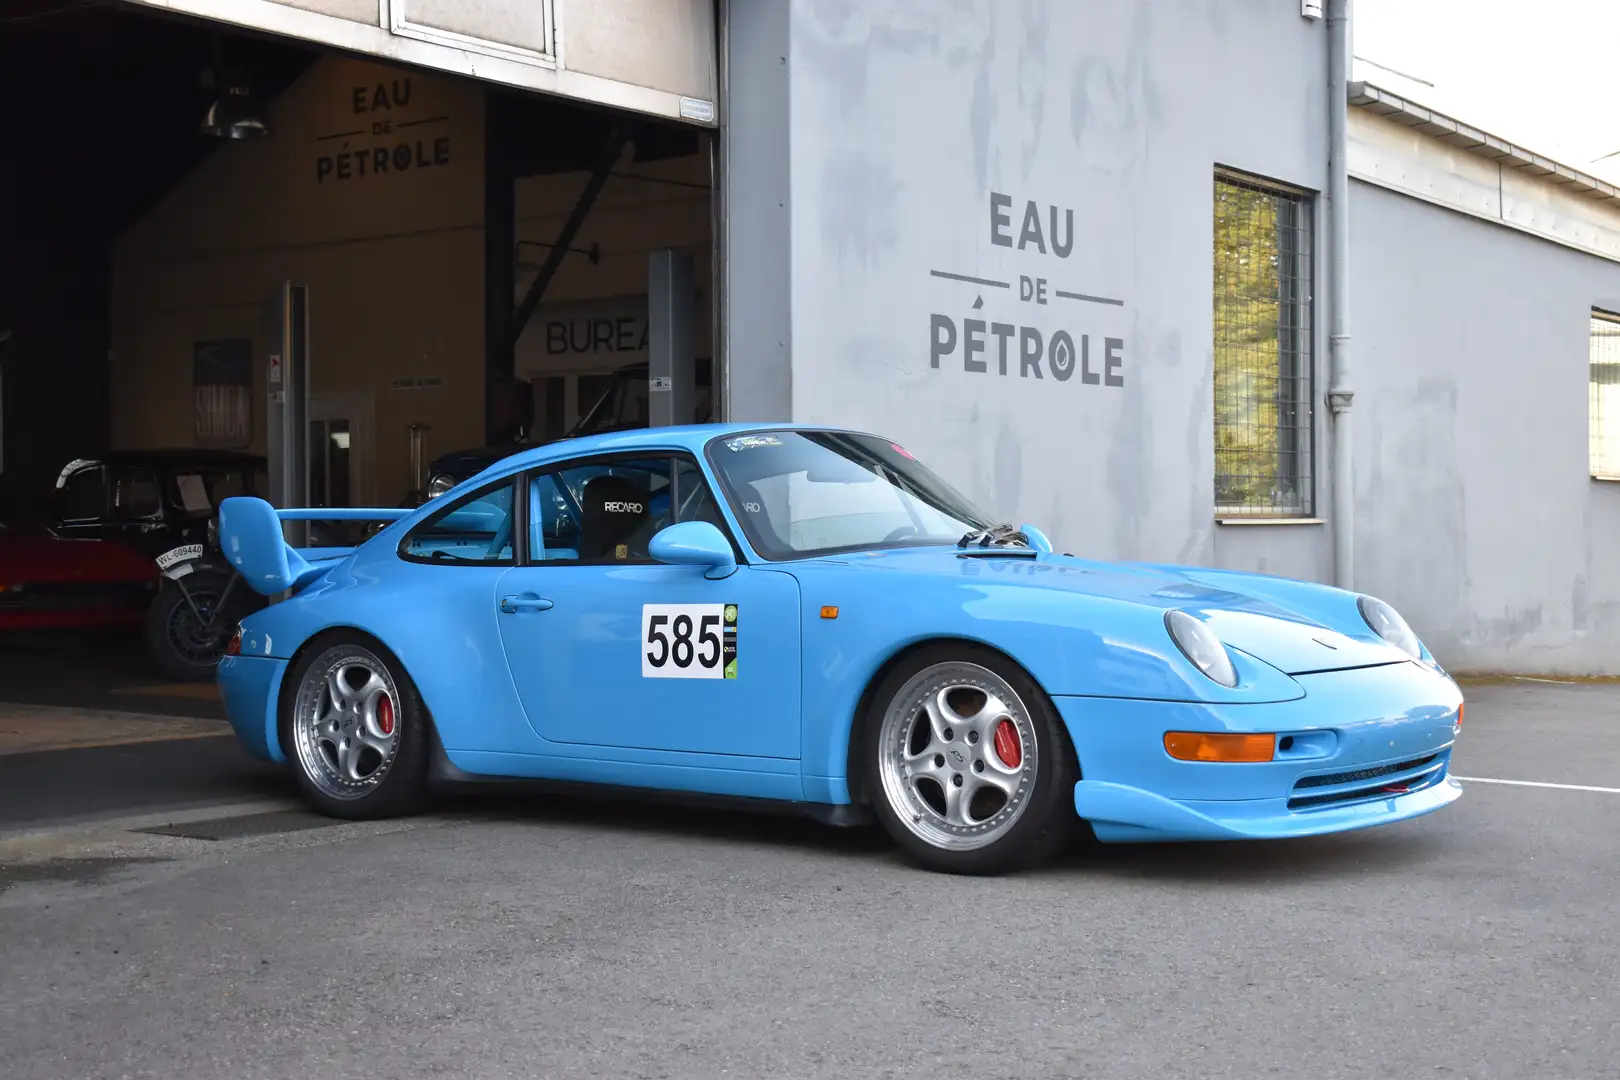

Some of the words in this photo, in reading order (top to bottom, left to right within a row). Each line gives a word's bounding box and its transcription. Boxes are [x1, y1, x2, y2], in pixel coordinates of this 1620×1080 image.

[353, 78, 411, 114] EAU
[372, 120, 393, 135] DE
[317, 137, 450, 184] PÉTROLE
[991, 191, 1074, 259] EAU
[1020, 274, 1048, 305] DE
[930, 294, 1124, 387] PÉTROLE
[604, 501, 644, 514] RECARO
[157, 544, 203, 566] WL-609440
[646, 613, 721, 669] 585
